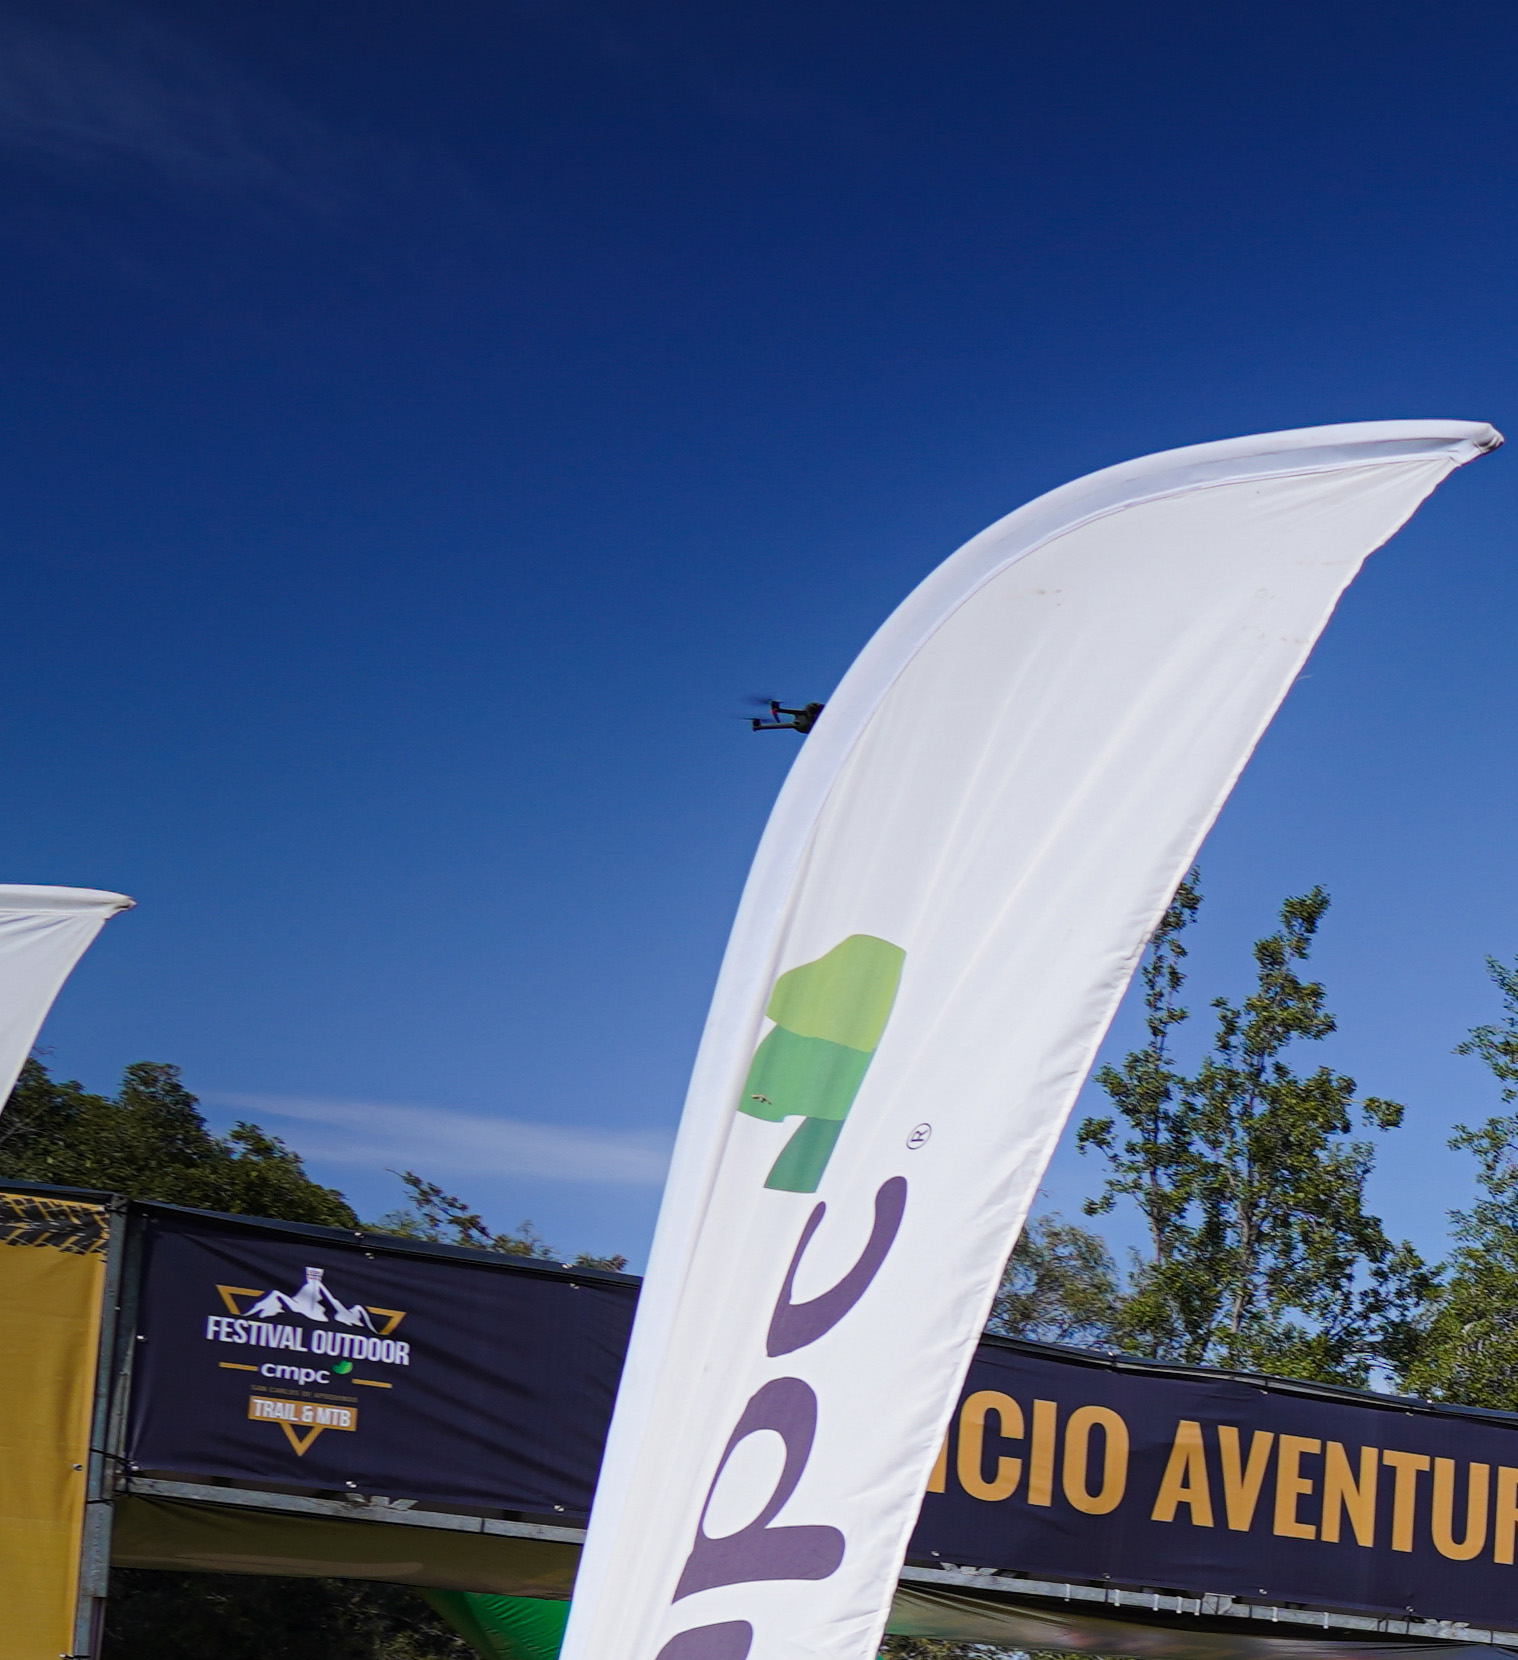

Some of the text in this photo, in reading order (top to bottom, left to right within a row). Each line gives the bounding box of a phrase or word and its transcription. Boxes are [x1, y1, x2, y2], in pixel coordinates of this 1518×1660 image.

[206, 1315, 411, 1366] FESTIVAL OUTDOOR
[260, 1363, 331, 1385] cmpc
[252, 1399, 352, 1427] TRAIL & MTB
[926, 1390, 1130, 1515] CIO
